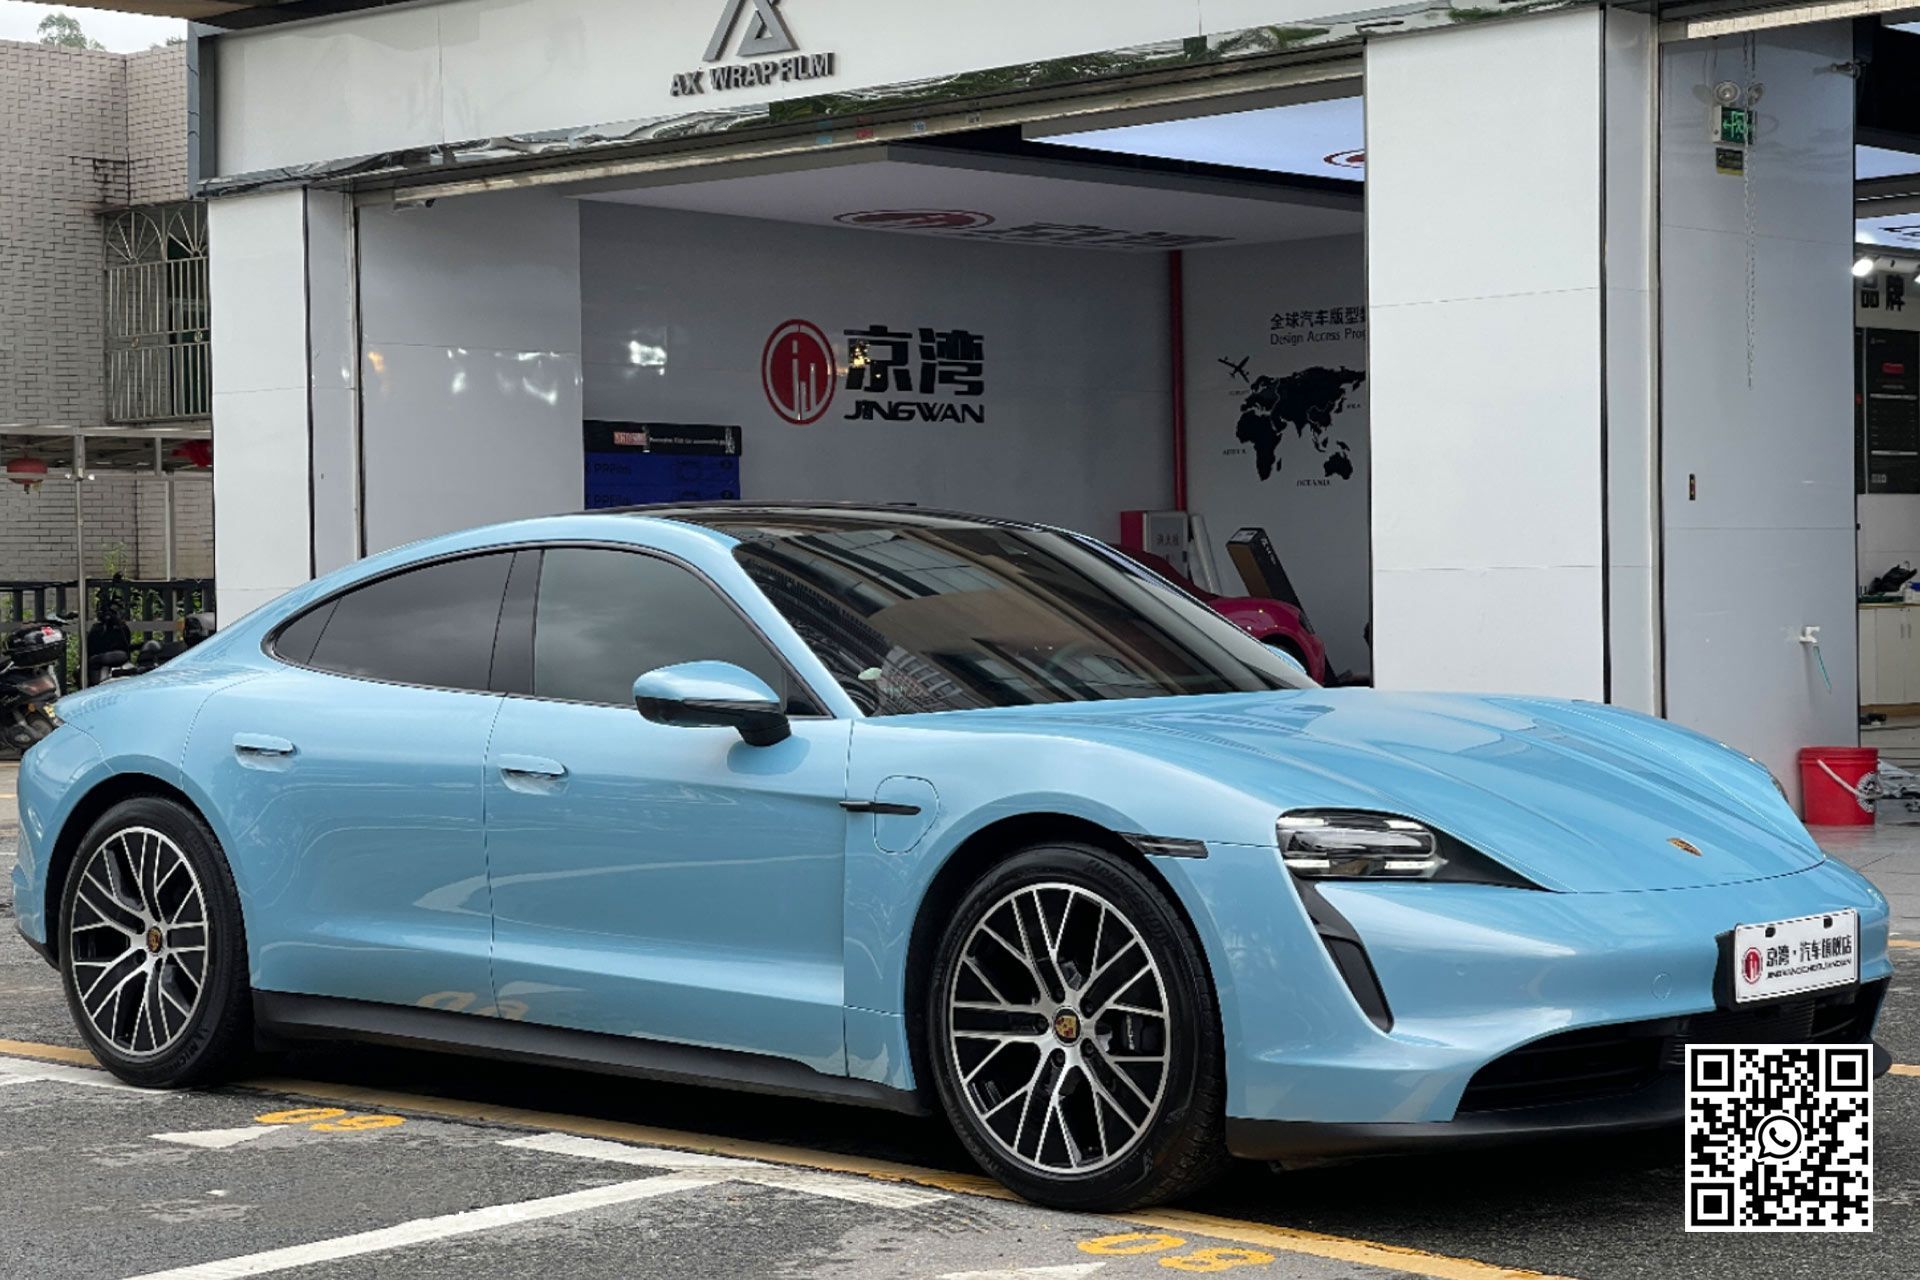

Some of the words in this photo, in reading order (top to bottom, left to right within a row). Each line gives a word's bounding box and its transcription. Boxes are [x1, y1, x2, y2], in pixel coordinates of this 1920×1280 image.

[670, 71, 705, 97] AX
[1270, 333, 1303, 347] Design
[843, 325, 985, 396] 京湾
[843, 400, 985, 424] JINGWAN
